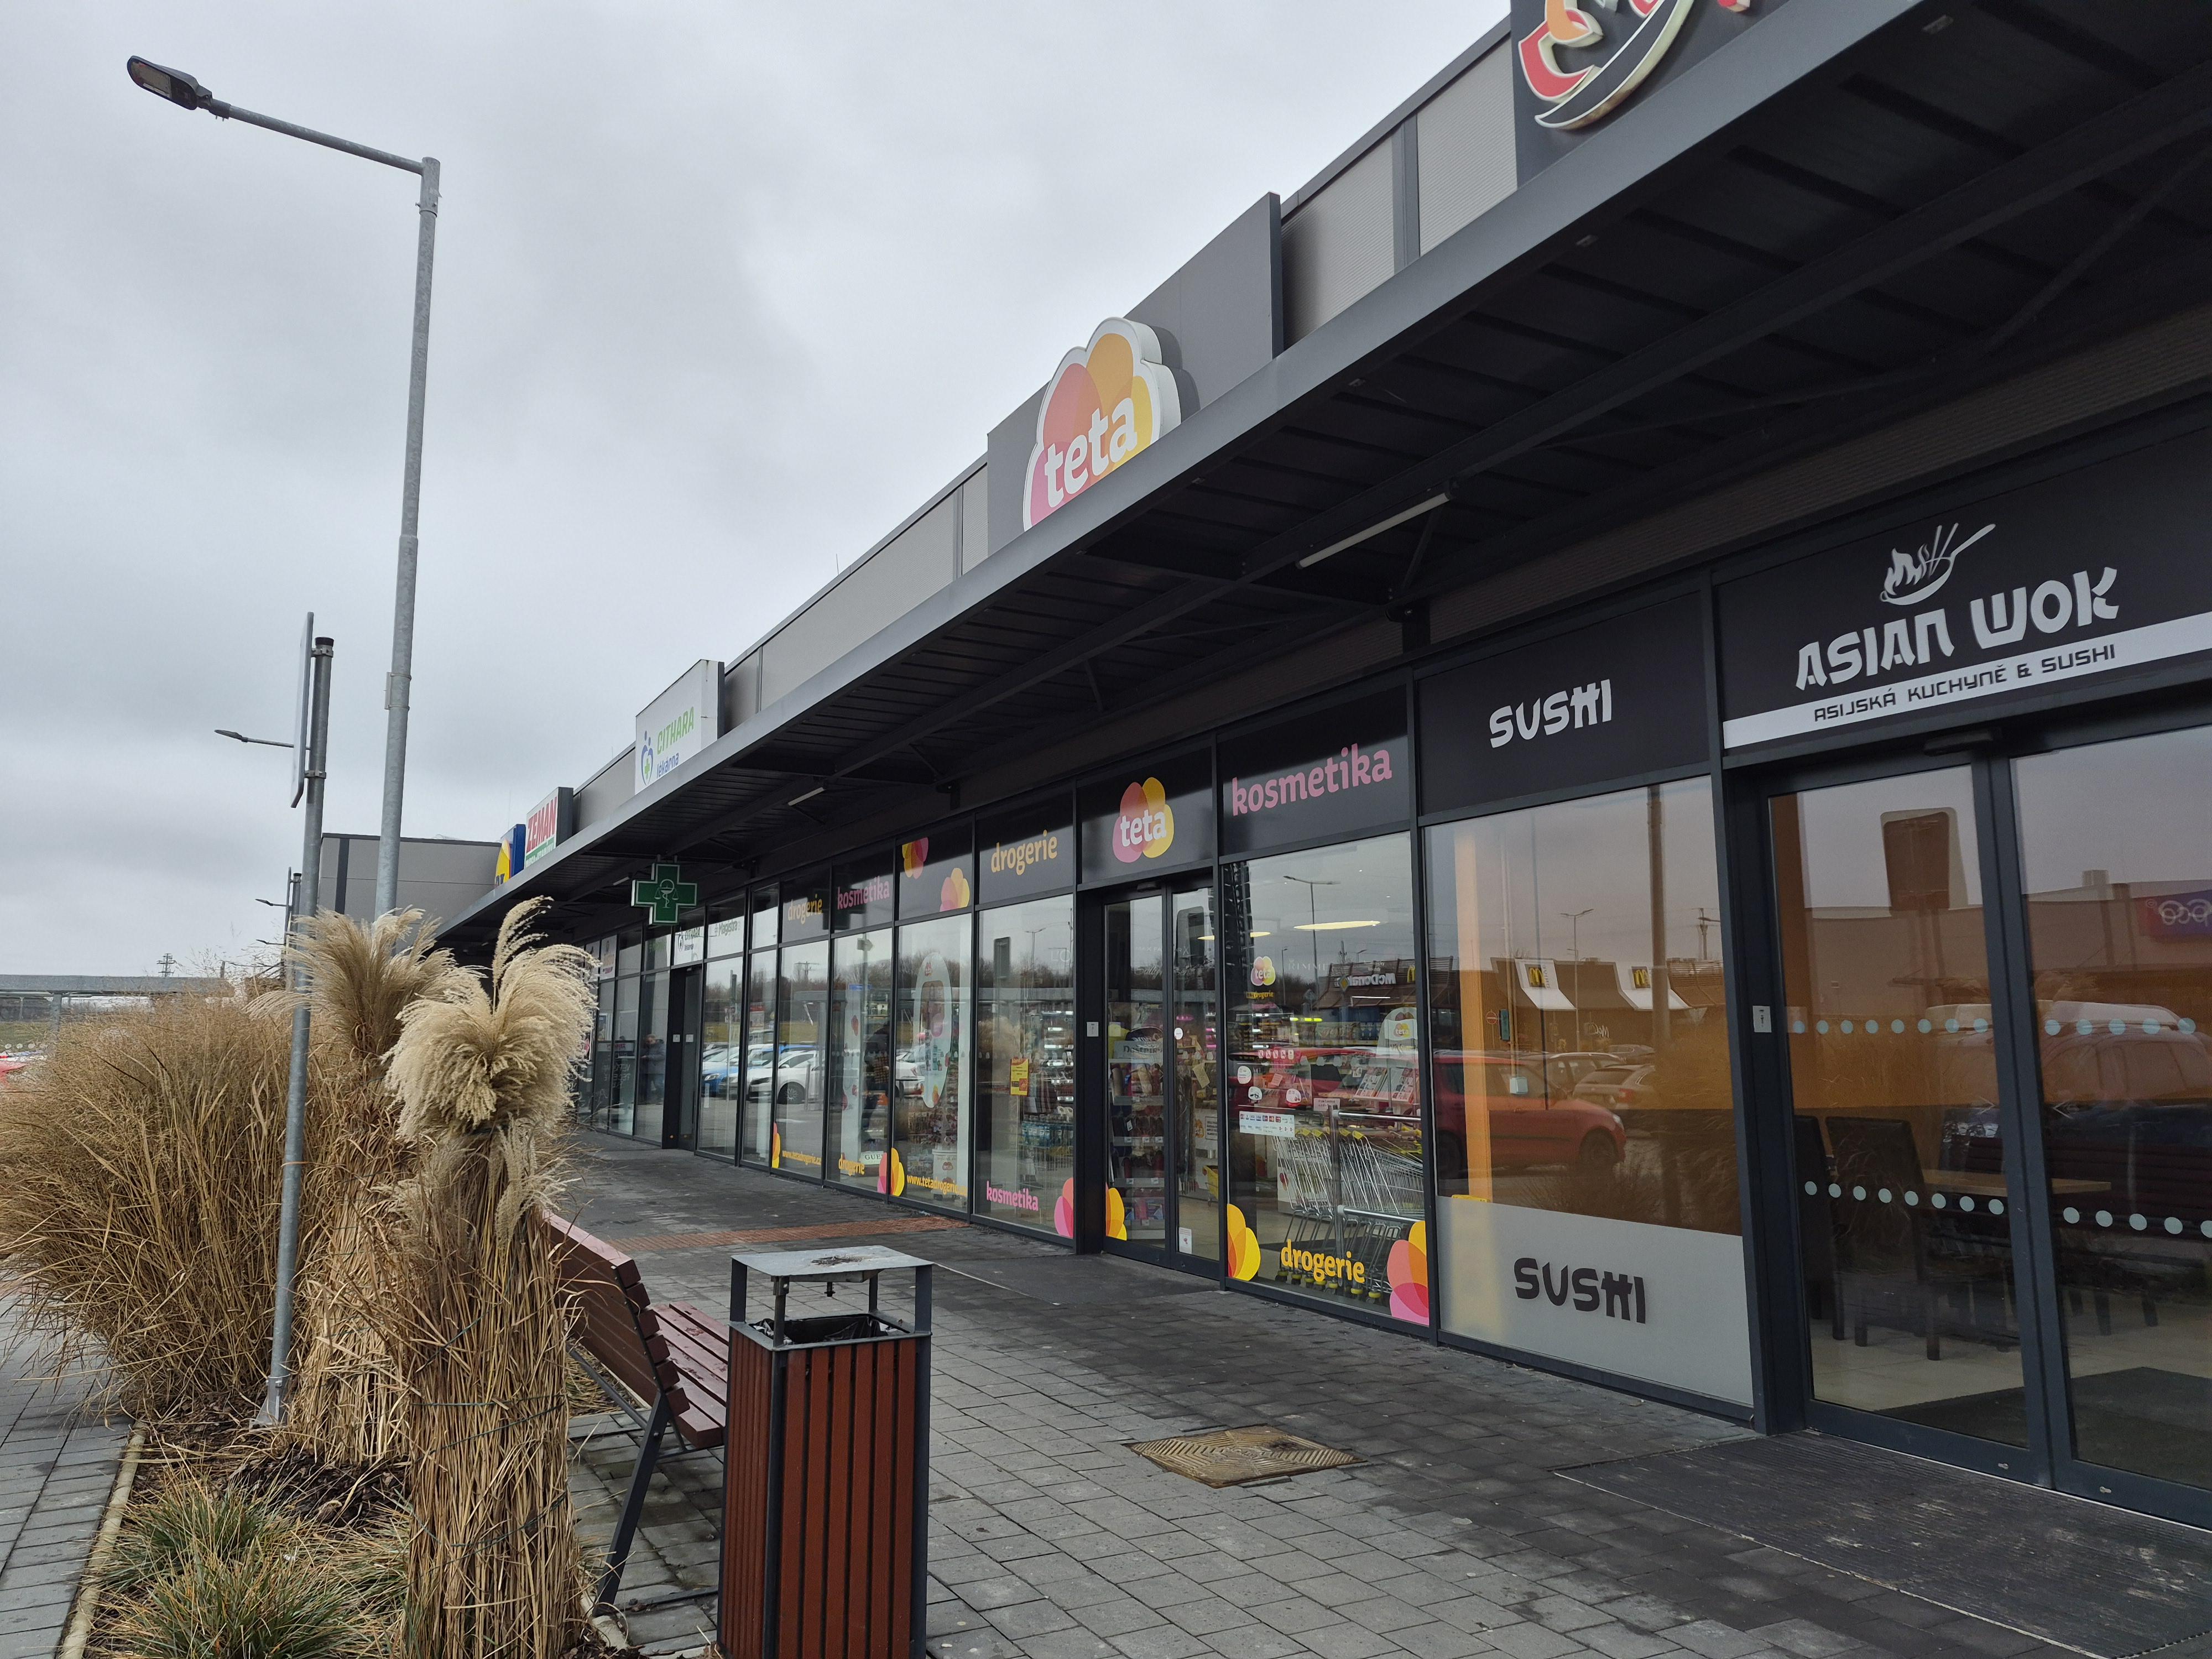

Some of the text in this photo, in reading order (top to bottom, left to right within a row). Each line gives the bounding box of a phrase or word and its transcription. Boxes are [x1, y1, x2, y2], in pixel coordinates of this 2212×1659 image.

[1045, 398, 1138, 508] teta
[1796, 567, 2120, 691] ASIAN WOK
[1814, 643, 2115, 722] ASIJSKÁ KUCHYNĚ & SUSHI
[657, 706, 694, 755] CITHARA
[1489, 679, 1612, 748] SUSHI
[656, 753, 679, 779] lékárna
[1232, 743, 1392, 816] kosmetika
[526, 796, 557, 853] ZEMAN
[1120, 809, 1166, 847] teta
[990, 829, 1057, 876] drogerie
[787, 893, 823, 925] drogerie
[837, 875, 890, 910] kosmetika
[1255, 969, 1272, 979] teta
[838, 1154, 865, 1177] drogerie
[986, 1180, 1039, 1211] kosmetika
[1280, 1239, 1366, 1284] drogerie
[1514, 1257, 1646, 1324] SUSHI
